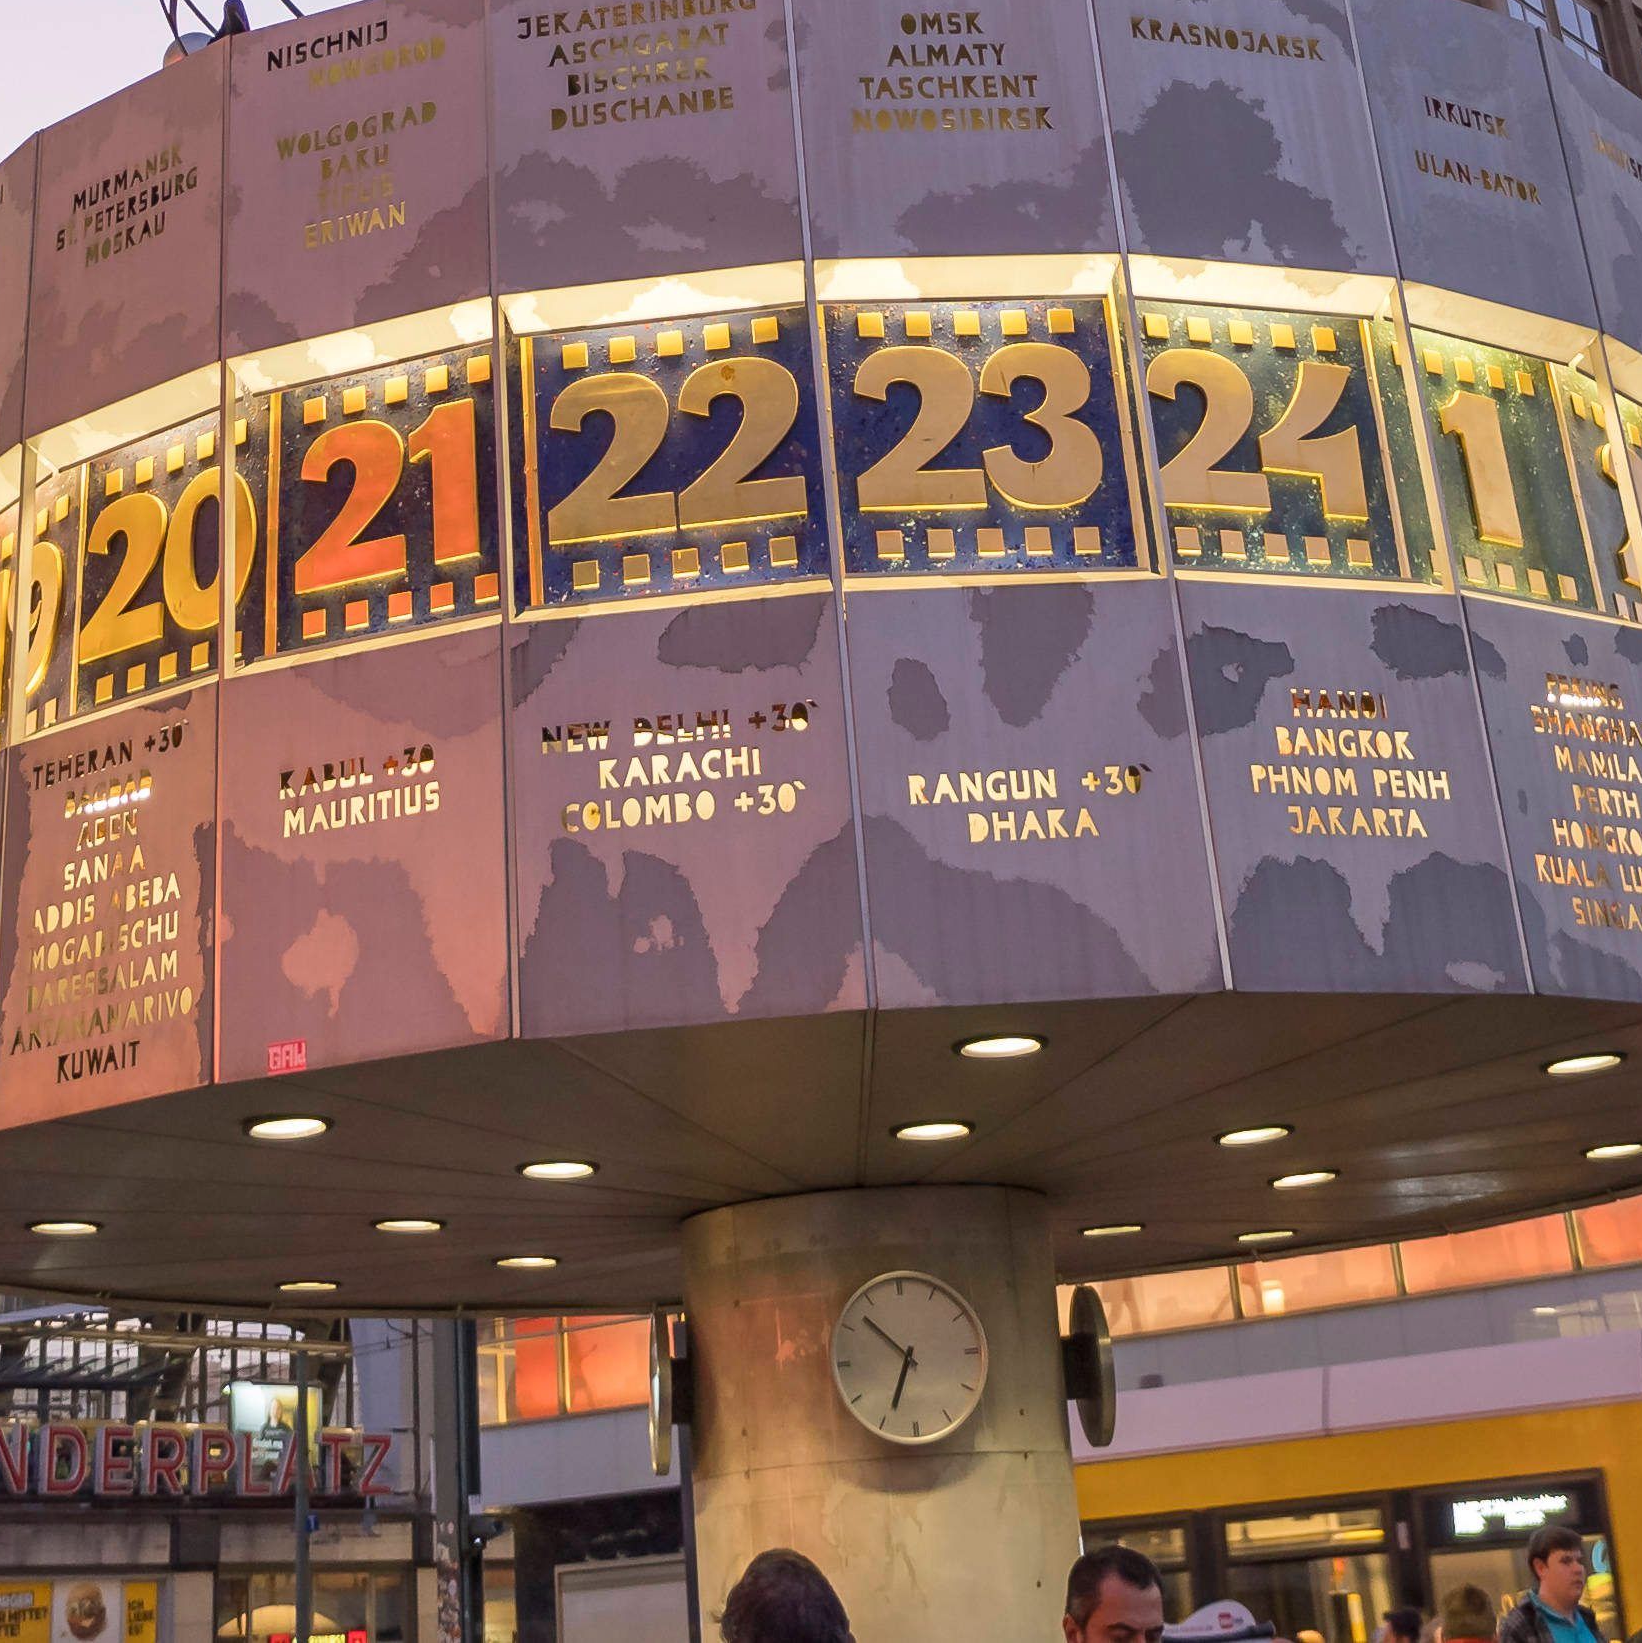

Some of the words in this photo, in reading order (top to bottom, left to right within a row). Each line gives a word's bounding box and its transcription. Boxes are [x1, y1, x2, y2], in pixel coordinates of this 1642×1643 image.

[267, 20, 388, 72] NISCHNIJ
[547, 23, 730, 68] ASCHGABAT
[900, 11, 985, 37] OMSK
[1130, 15, 1325, 61] KRASNOJARSK
[887, 43, 1006, 68] ALMATY
[551, 87, 735, 131] DUSCHANBE
[858, 75, 1039, 100] TASCHKENT
[276, 100, 438, 161] WOLGOGRAD
[852, 106, 1055, 133] NOWOSIBIRSK
[1423, 95, 1510, 139] IRKUTSK
[72, 144, 184, 215] MURMANSK
[321, 143, 390, 181] BAKU
[1414, 148, 1542, 206] ULAN-BATOR
[83, 166, 198, 237] PETERSBURG
[84, 211, 166, 268] MOSKAU
[304, 200, 406, 250] ERIWAN
[853, 341, 1104, 511] 23
[1147, 347, 1369, 522] 24
[547, 356, 808, 546] 22
[1439, 389, 1525, 549] 1
[294, 397, 482, 597] 21
[78, 465, 258, 665] 20
[1289, 687, 1389, 720] HANOI
[540, 718, 612, 755] NEW
[633, 707, 734, 748] DELHI
[1274, 725, 1415, 761] BANGKOK
[32, 739, 133, 791] TEHERAN
[278, 755, 375, 801] KABUL
[598, 745, 764, 791] KARACHI
[908, 767, 1058, 808] RANGUN
[1249, 764, 1358, 798] PHNOM
[1372, 767, 1452, 801] PENH
[282, 780, 441, 839] MAURITIUS
[560, 788, 717, 835] COLOMBO
[1287, 804, 1430, 839] JAKARTA
[1571, 783, 1642, 821] PERTH
[75, 808, 139, 853] ADEN
[969, 806, 1102, 845] DHAKA
[1534, 852, 1612, 891] KUALA
[34, 894, 96, 935] ADDIS
[111, 872, 181, 913] ABEBA
[30, 909, 179, 973] MOGADSCHU
[27, 949, 178, 1015] DARESSALAM
[56, 1040, 141, 1084] KUWAIT
